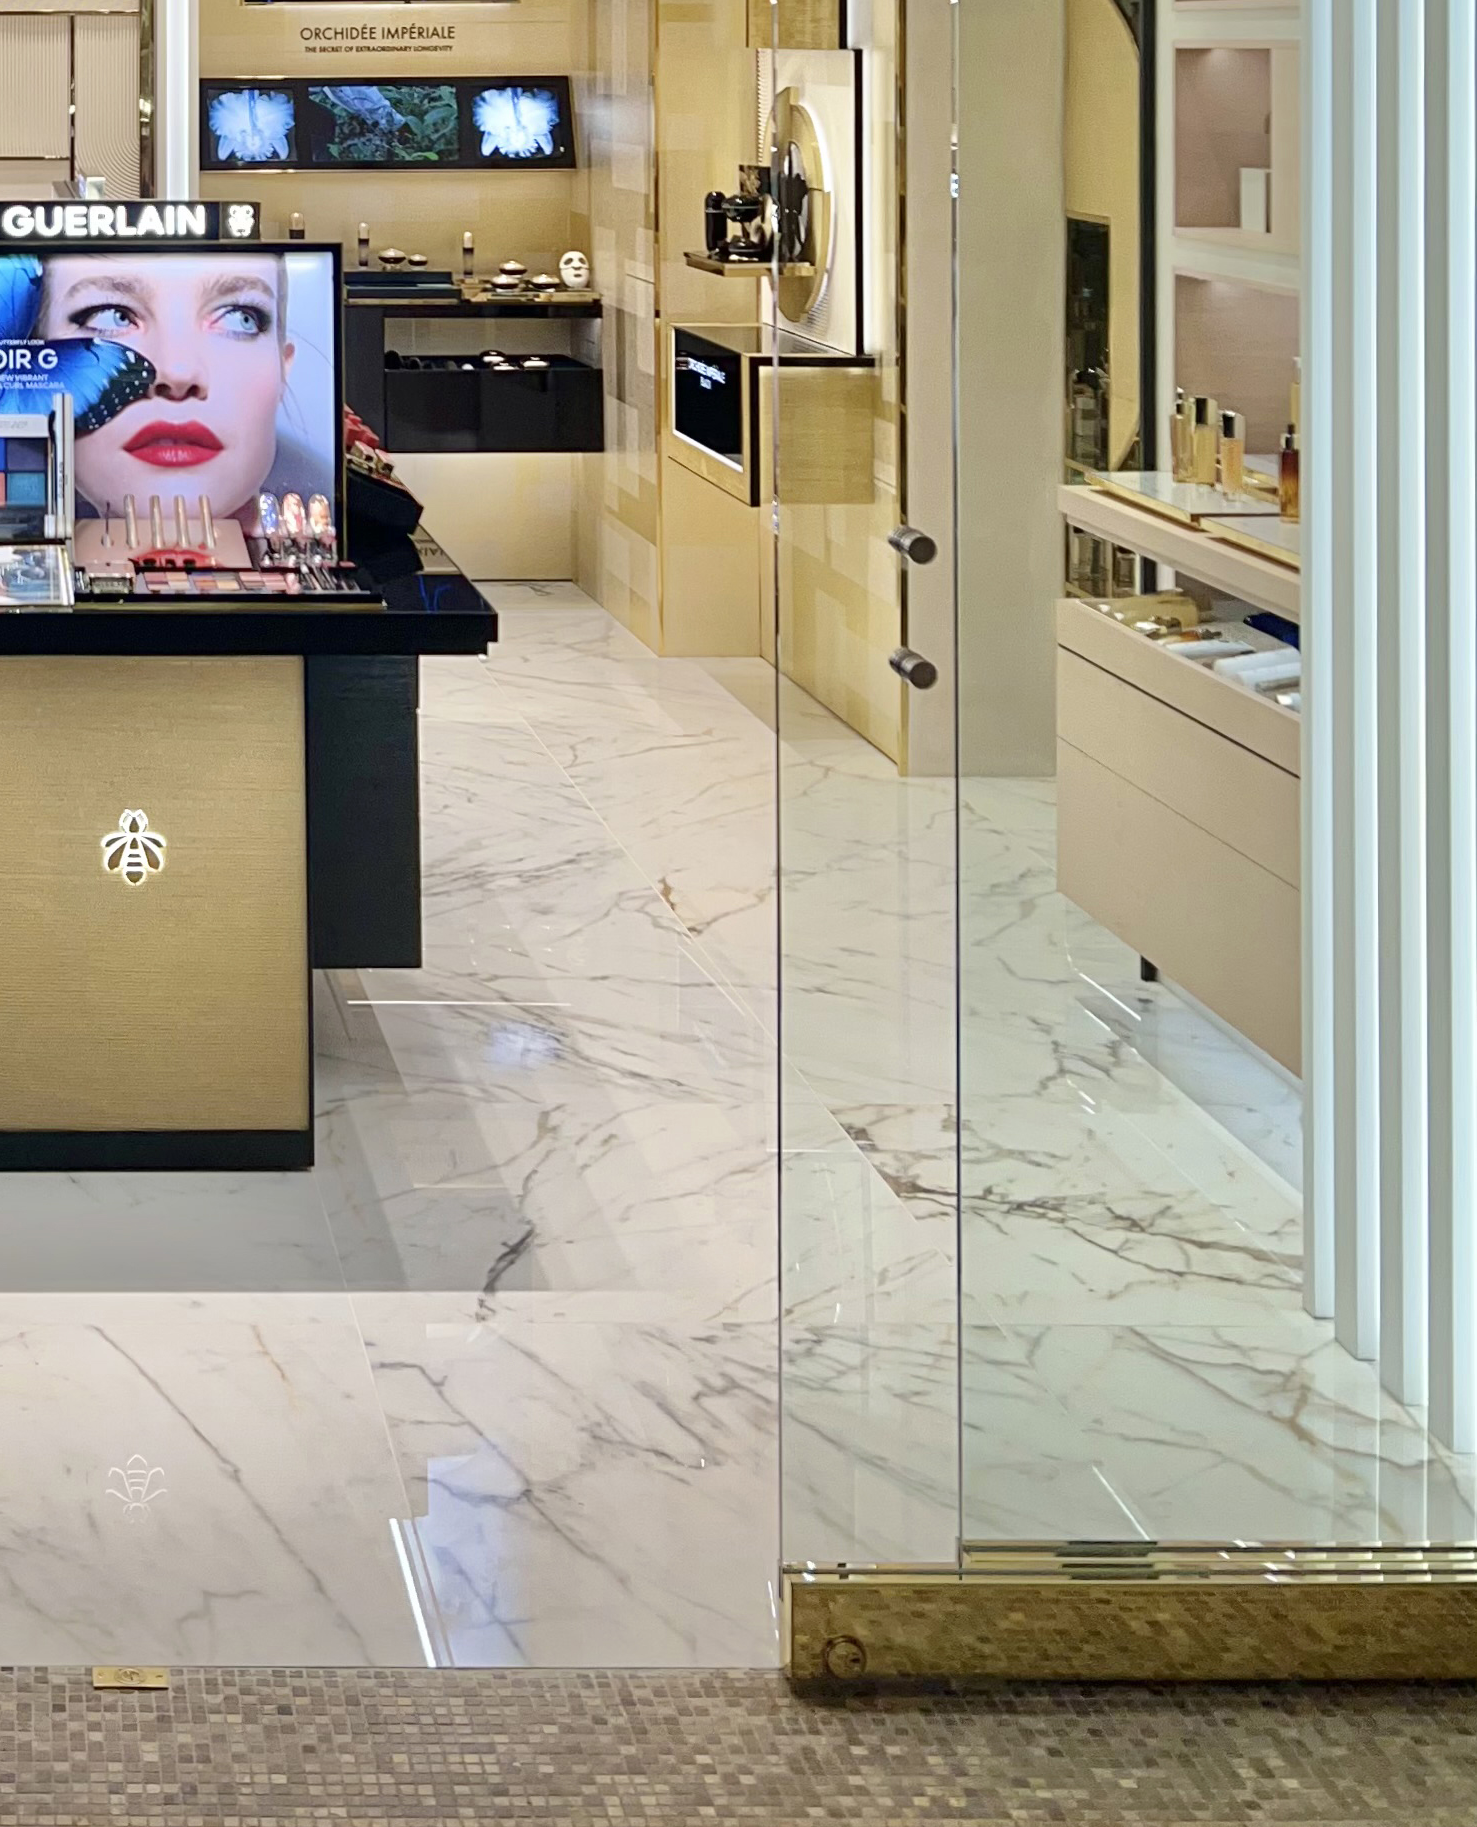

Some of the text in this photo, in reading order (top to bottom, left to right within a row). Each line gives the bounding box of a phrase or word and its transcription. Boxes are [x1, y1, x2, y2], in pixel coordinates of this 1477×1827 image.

[300, 23, 456, 41] ORCHIDÉE IMPÉRIALE
[304, 46, 317, 54] THE
[3, 205, 207, 237] GUERLAIN
[37, 348, 59, 370] G
[15, 374, 49, 382] VIBRANT
